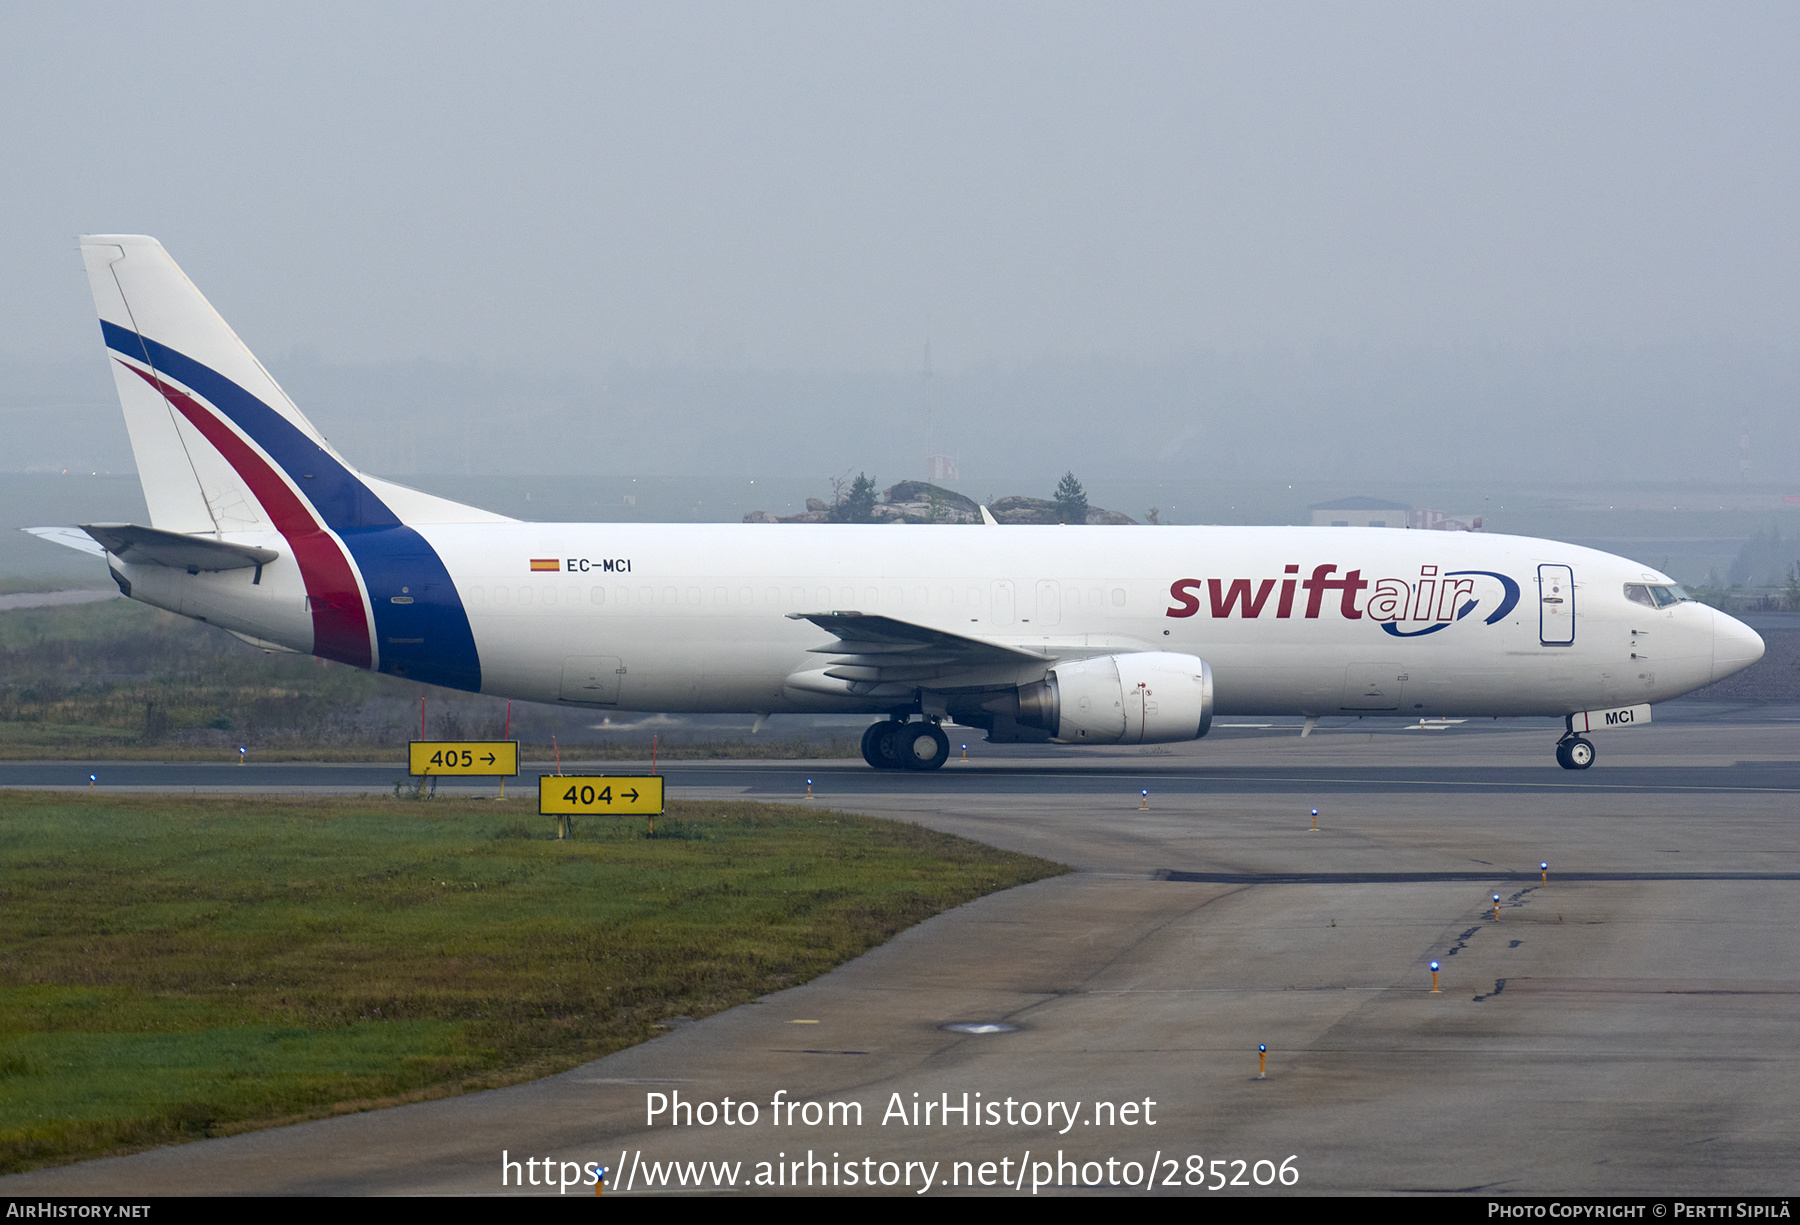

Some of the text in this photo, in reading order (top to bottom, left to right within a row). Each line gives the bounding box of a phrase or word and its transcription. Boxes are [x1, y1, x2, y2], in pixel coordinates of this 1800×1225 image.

[566, 558, 631, 572] EC-MCI
[1166, 563, 1474, 622] swiftair
[1605, 709, 1635, 725] MCI
[429, 750, 473, 768] 405
[563, 785, 613, 805] 404
